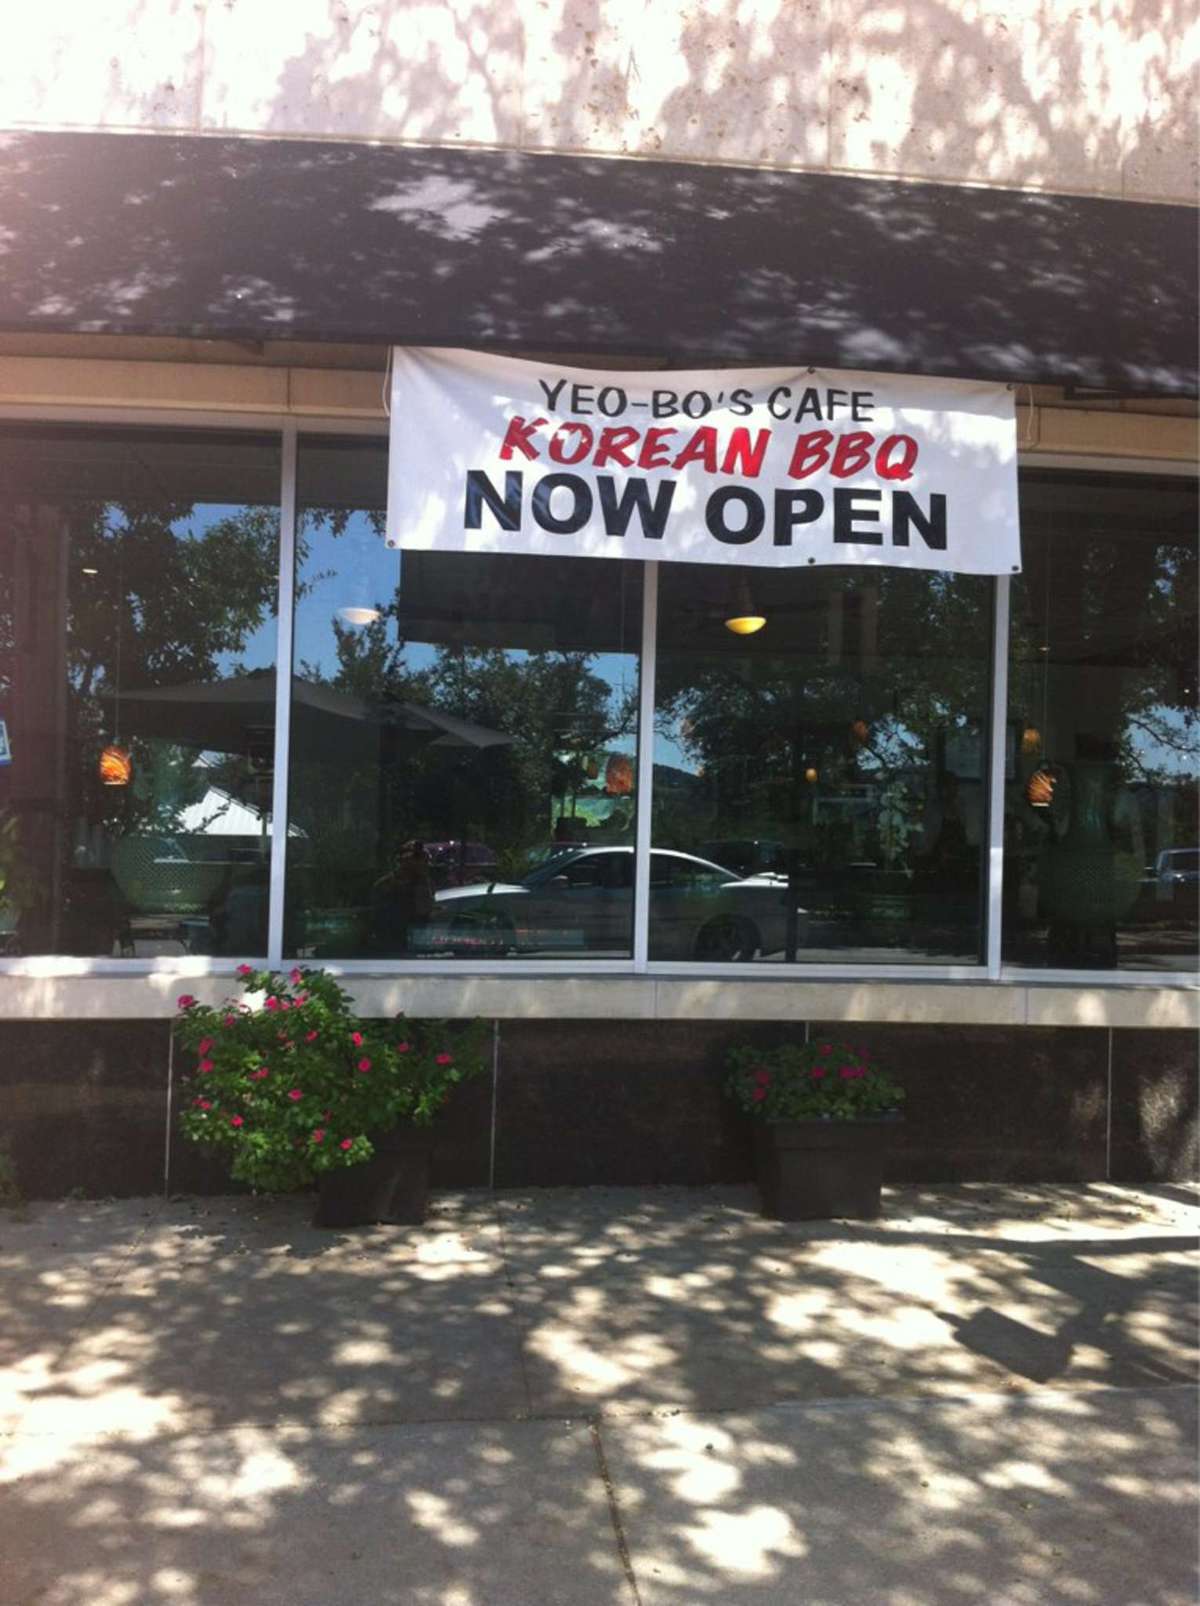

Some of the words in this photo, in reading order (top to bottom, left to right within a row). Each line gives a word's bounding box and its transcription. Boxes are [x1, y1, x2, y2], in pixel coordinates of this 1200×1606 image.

[537, 378, 753, 419] YEO-BO'S
[767, 387, 875, 423] CAFE
[500, 416, 771, 478] KOREAN
[788, 430, 919, 482] BBQ
[464, 471, 676, 539] NOW
[706, 485, 947, 551] OPEN
